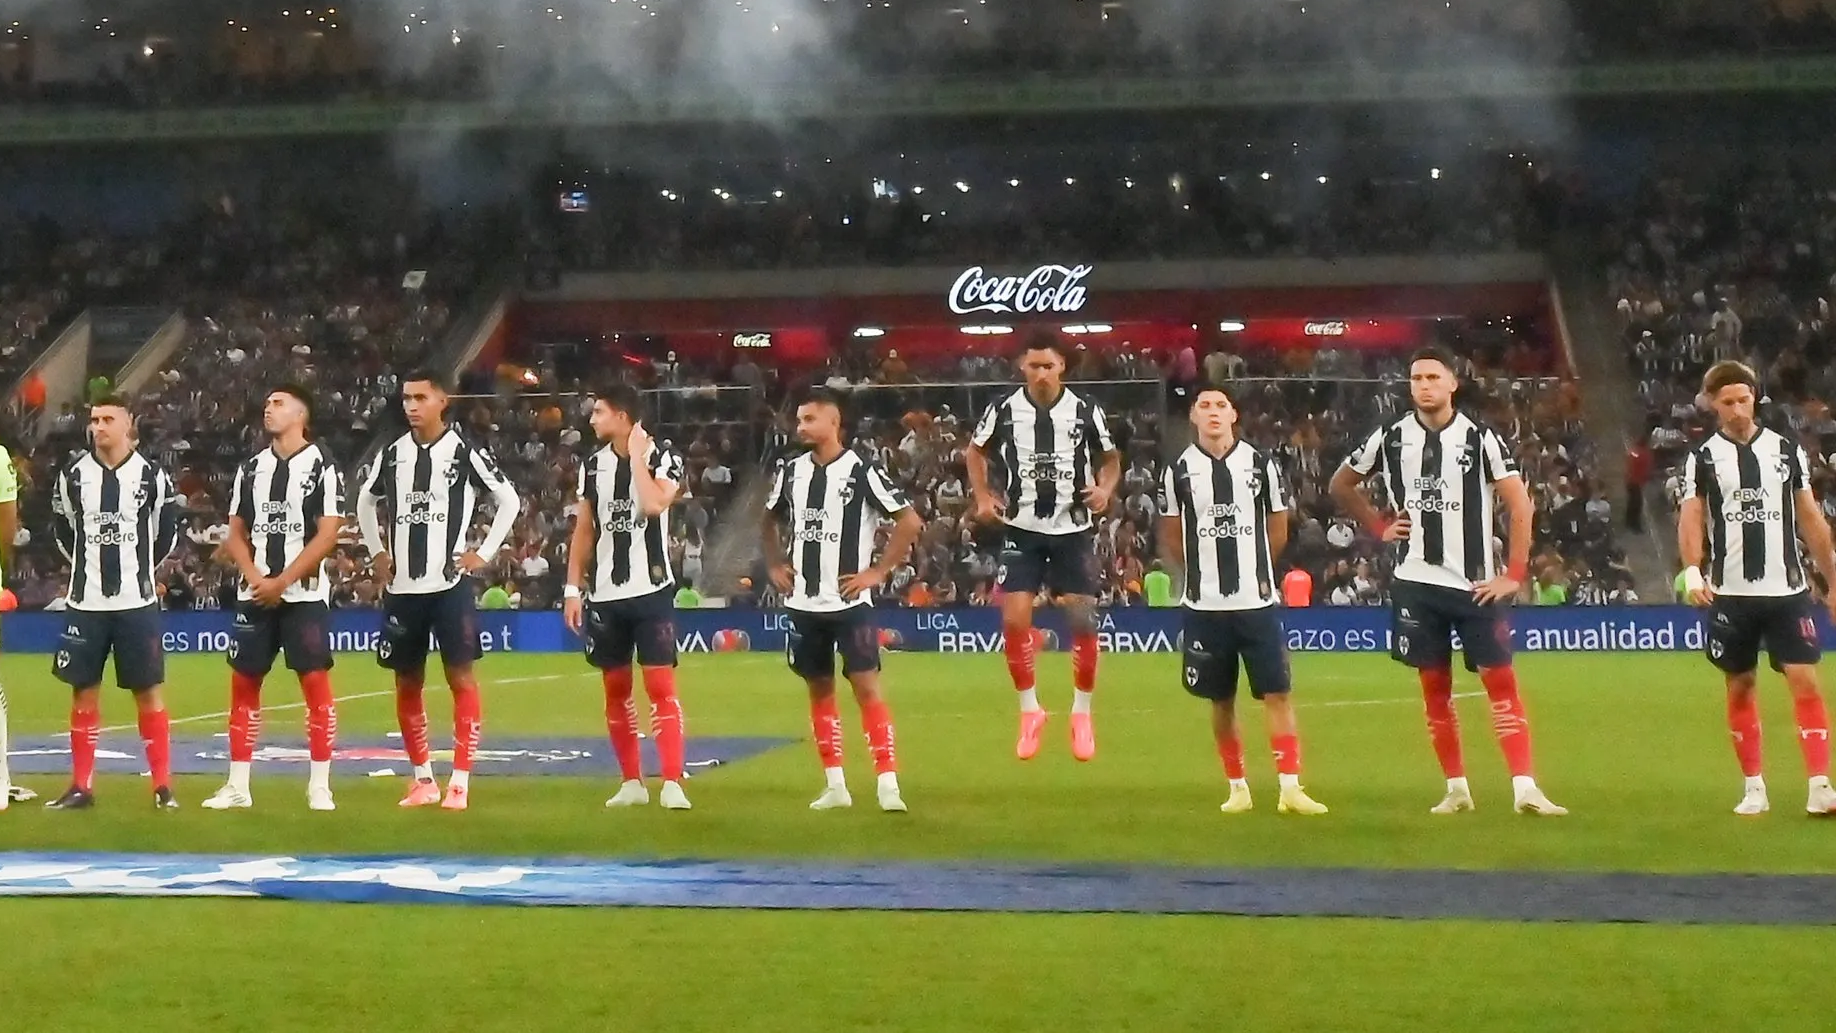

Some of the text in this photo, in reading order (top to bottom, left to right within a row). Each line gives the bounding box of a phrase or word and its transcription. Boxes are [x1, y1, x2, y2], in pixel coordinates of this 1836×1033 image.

[949, 264, 1092, 314] Coca-Cola
[1020, 465, 1073, 480] codere
[1413, 478, 1449, 490] BBVA
[405, 491, 436, 504] BBVA
[1732, 488, 1769, 501] BBVA
[261, 501, 292, 514] BBVA
[1207, 505, 1242, 517] BBVA
[1407, 498, 1461, 512] codere
[93, 514, 126, 525] BBVA
[396, 509, 446, 525] codere
[1725, 508, 1781, 522] codere
[253, 518, 303, 534] codere
[1198, 523, 1253, 538] codere
[87, 528, 136, 544] codere
[917, 613, 959, 630] LIGA
[162, 631, 230, 652] es no
[676, 631, 709, 653] VA
[1344, 631, 1376, 651] es
[1525, 621, 1675, 651] anualidad
